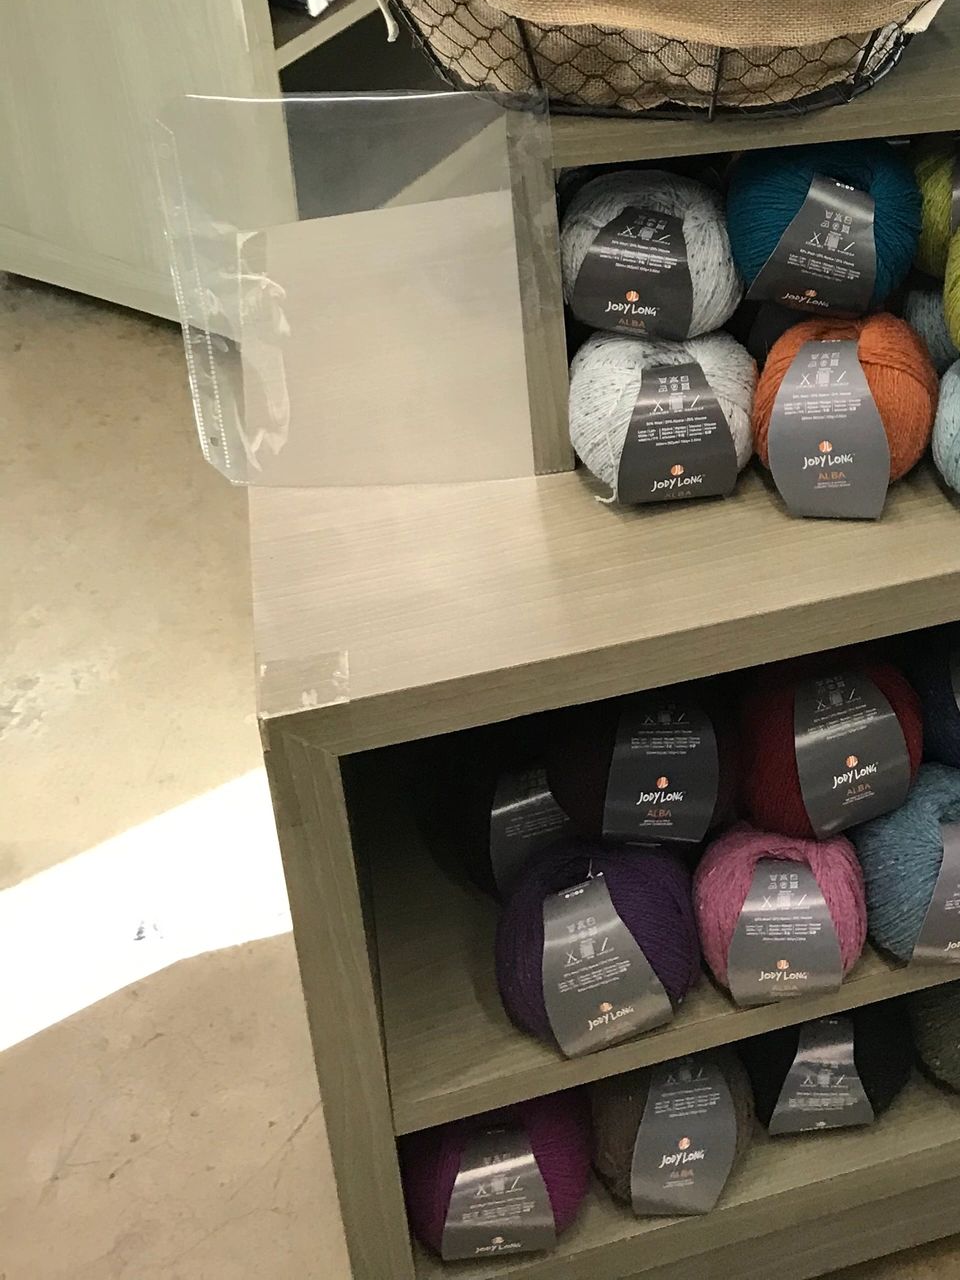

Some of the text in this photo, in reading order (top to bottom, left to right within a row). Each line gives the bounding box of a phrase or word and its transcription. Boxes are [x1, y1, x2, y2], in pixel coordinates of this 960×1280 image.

[605, 301, 657, 316] JODY LONG
[802, 454, 852, 470] JODY LONG
[651, 475, 702, 492] JODY LONG
[832, 763, 876, 790] JODY LONG
[636, 792, 684, 806] JODY LONG
[758, 971, 808, 982] JODY LONG
[588, 1006, 634, 1031] JODY LONG
[658, 1149, 705, 1168] JODY LONG
